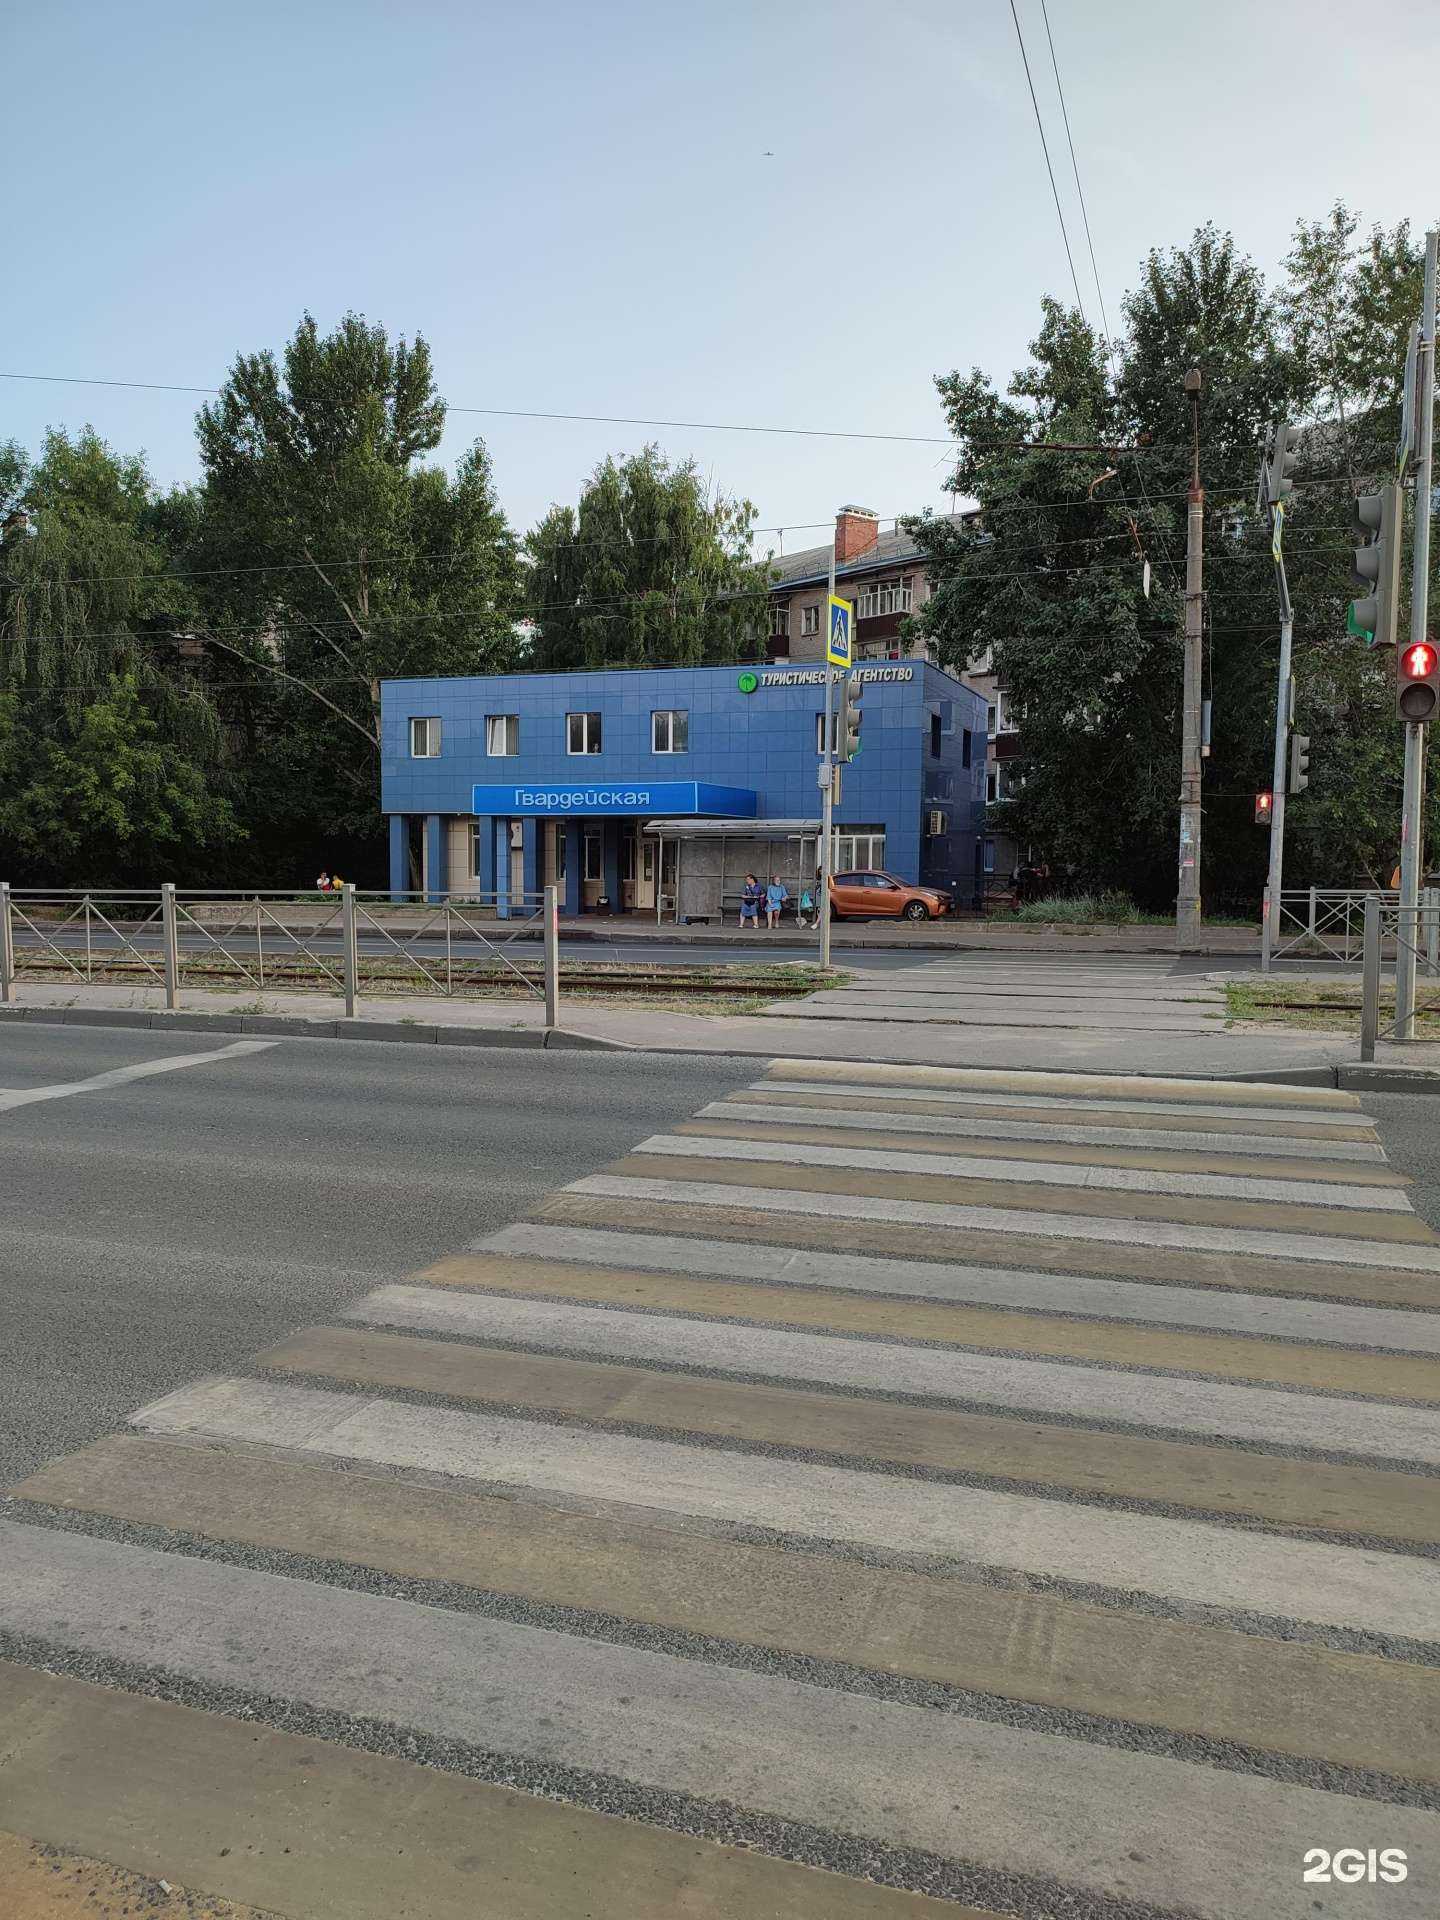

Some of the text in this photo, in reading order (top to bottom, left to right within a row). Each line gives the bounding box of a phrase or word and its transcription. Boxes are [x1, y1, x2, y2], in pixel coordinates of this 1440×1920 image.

[760, 667, 913, 686] ТУРИСТИЧЕСОЕ АГЕНТСТВО
[514, 789, 650, 810] Гвардейская
